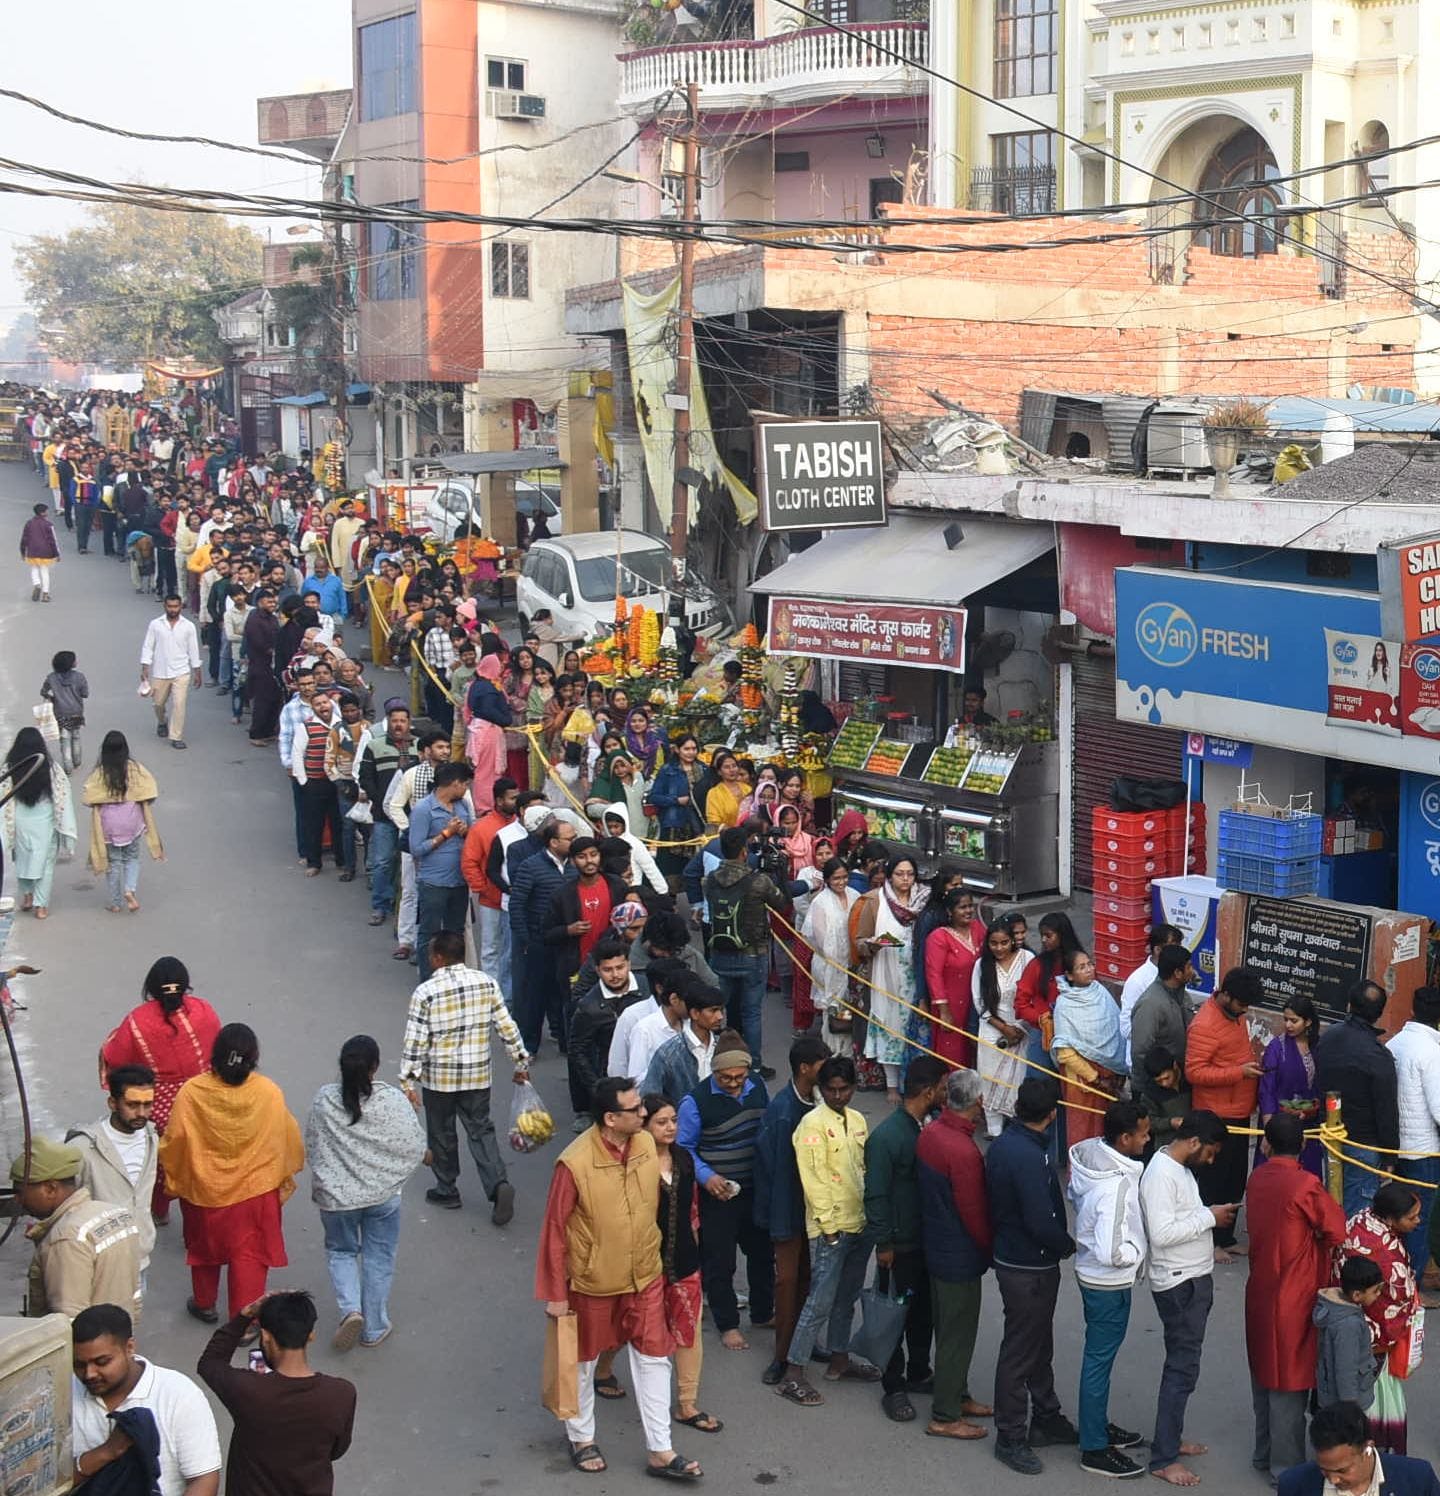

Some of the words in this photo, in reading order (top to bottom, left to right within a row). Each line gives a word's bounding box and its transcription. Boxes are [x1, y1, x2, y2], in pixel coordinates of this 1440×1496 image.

[773, 440, 873, 479] TABISH
[775, 488, 820, 510] CLOTH
[823, 484, 875, 508] CENTER
[793, 611, 848, 632] मनकामेश्वर
[850, 613, 877, 635] मंदिर
[879, 620, 898, 643] जूस
[901, 617, 932, 639] कार्नर
[1141, 609, 1193, 656] Gyan
[1202, 628, 1269, 662] FRESH
[1416, 655, 1440, 678] Gyan
[1249, 939, 1259, 950] श्री
[1250, 920, 1277, 937] श्रीमती
[1279, 928, 1303, 944] सुषमा
[1247, 956, 1272, 970] श्रीमती
